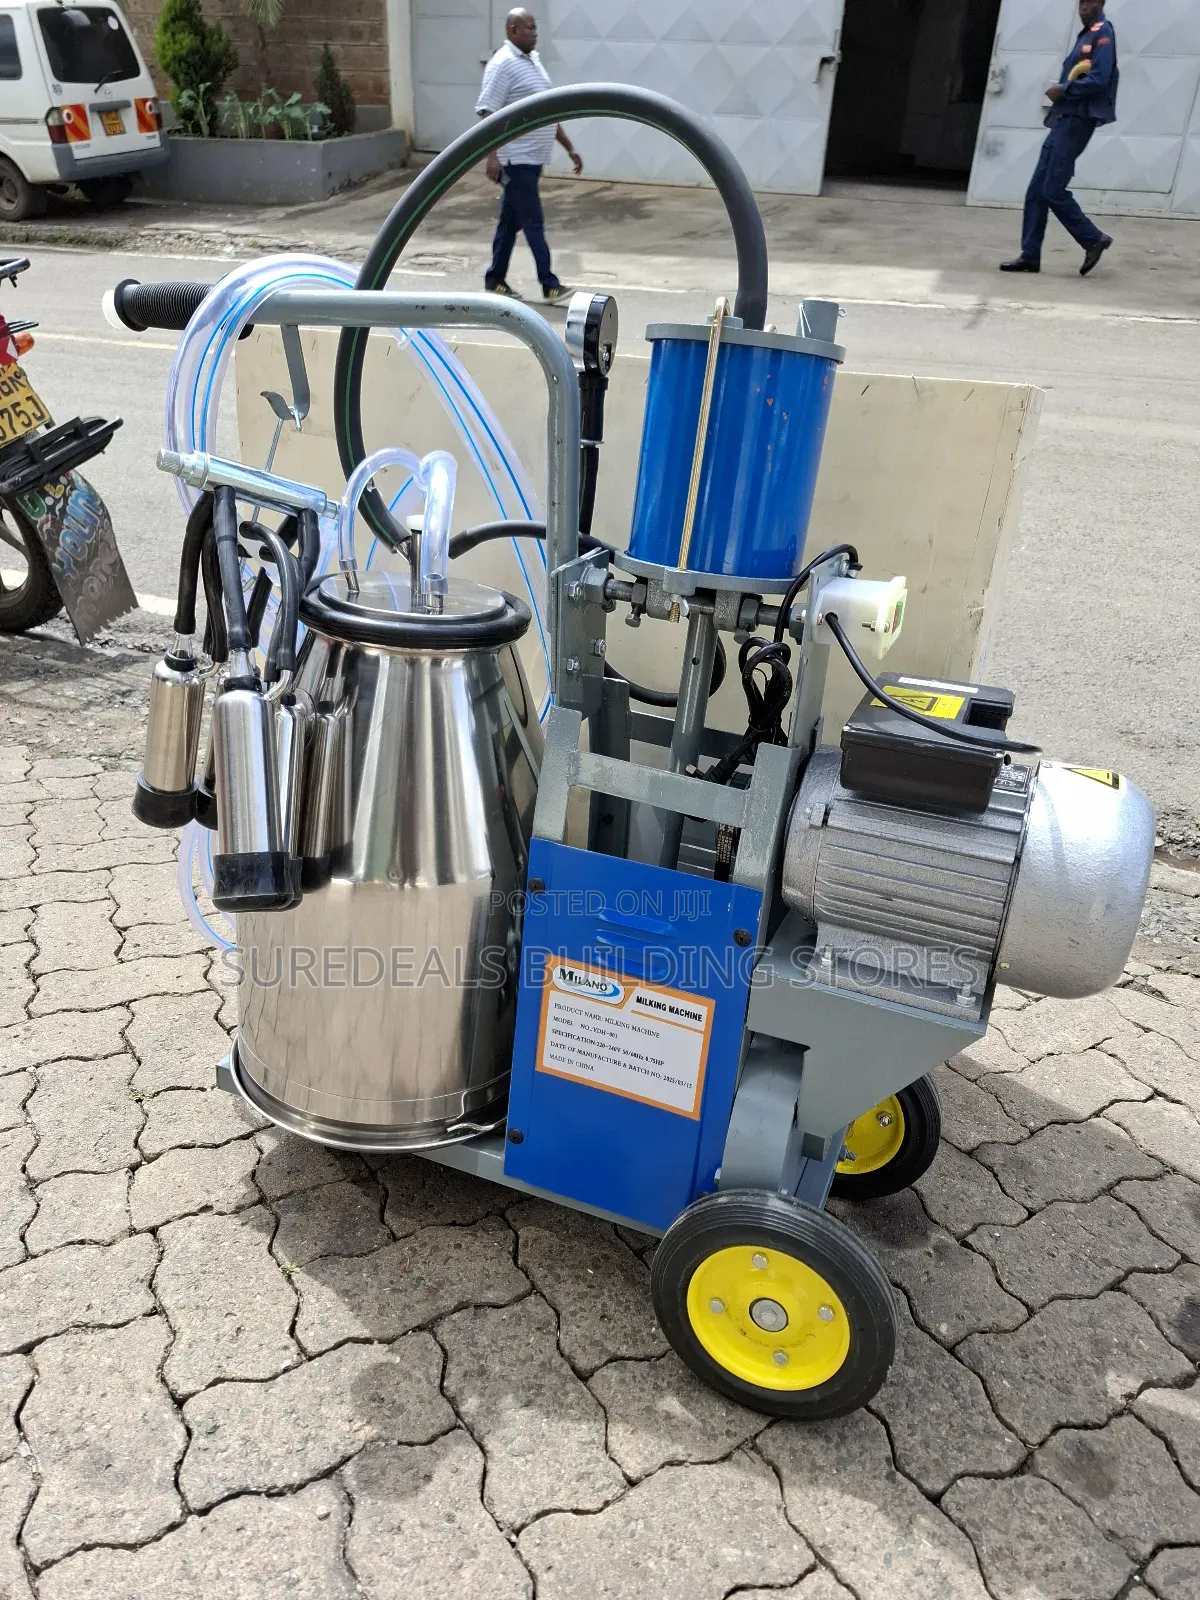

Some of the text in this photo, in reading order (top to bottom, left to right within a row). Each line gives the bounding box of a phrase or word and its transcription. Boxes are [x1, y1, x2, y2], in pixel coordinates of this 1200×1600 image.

[552, 1015, 574, 1027] MODEL
[554, 1002, 660, 1038] PRODUCT NAME: MILKING MACHINE
[636, 995, 703, 1022] MILKING MACHINE
[549, 1053, 595, 1072] MADE IN CHINA
[550, 1040, 567, 1051] DATE
[567, 1045, 576, 1054] OF
[576, 1047, 622, 1067] MANUFACTURE
[628, 1063, 650, 1076] BATCH
